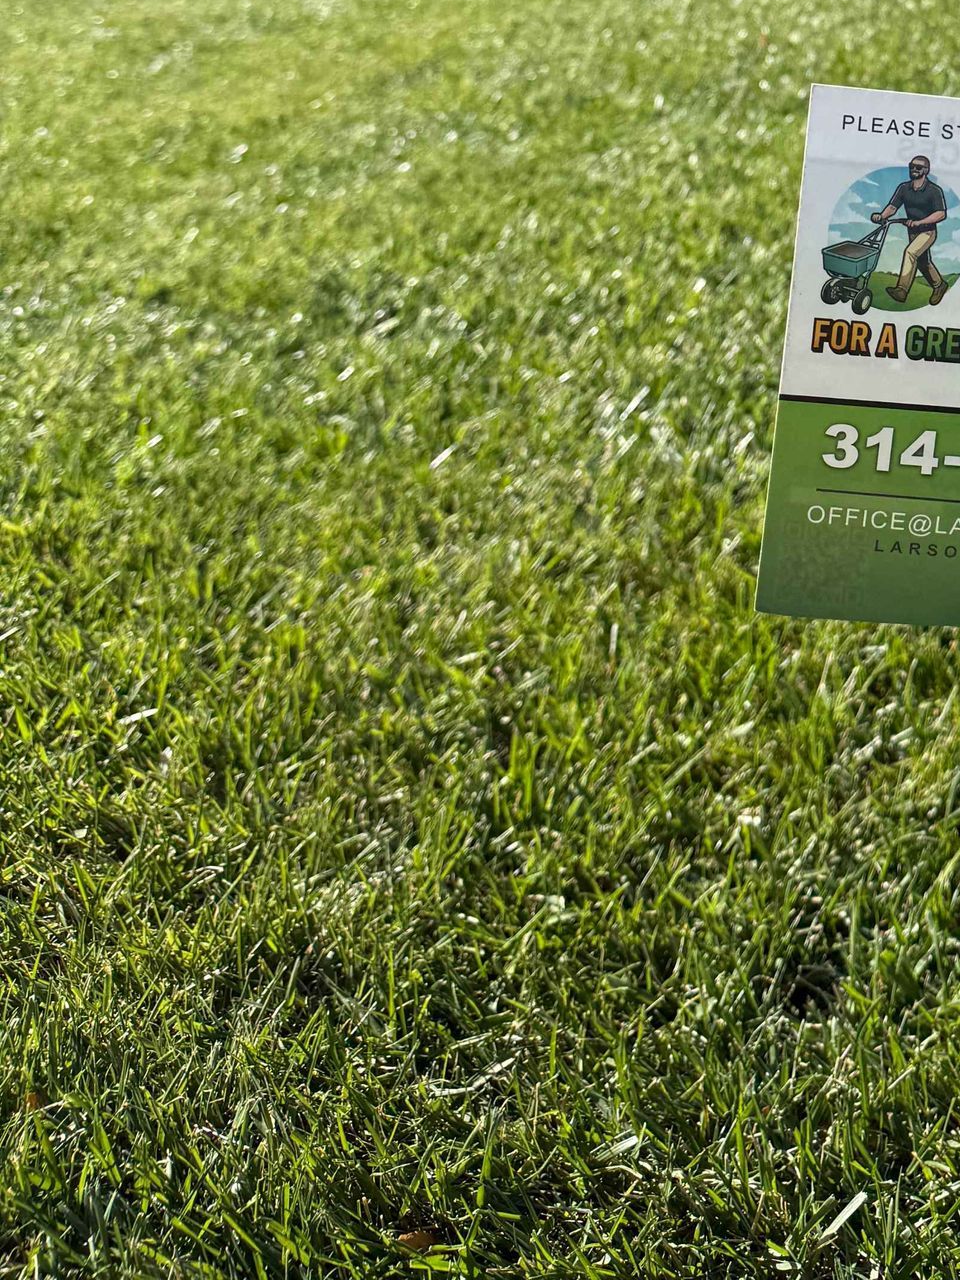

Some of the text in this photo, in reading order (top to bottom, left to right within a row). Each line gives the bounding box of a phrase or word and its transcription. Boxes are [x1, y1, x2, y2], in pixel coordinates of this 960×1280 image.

[842, 114, 931, 138] PLEASE
[811, 317, 872, 357] FOR
[874, 322, 899, 359] A
